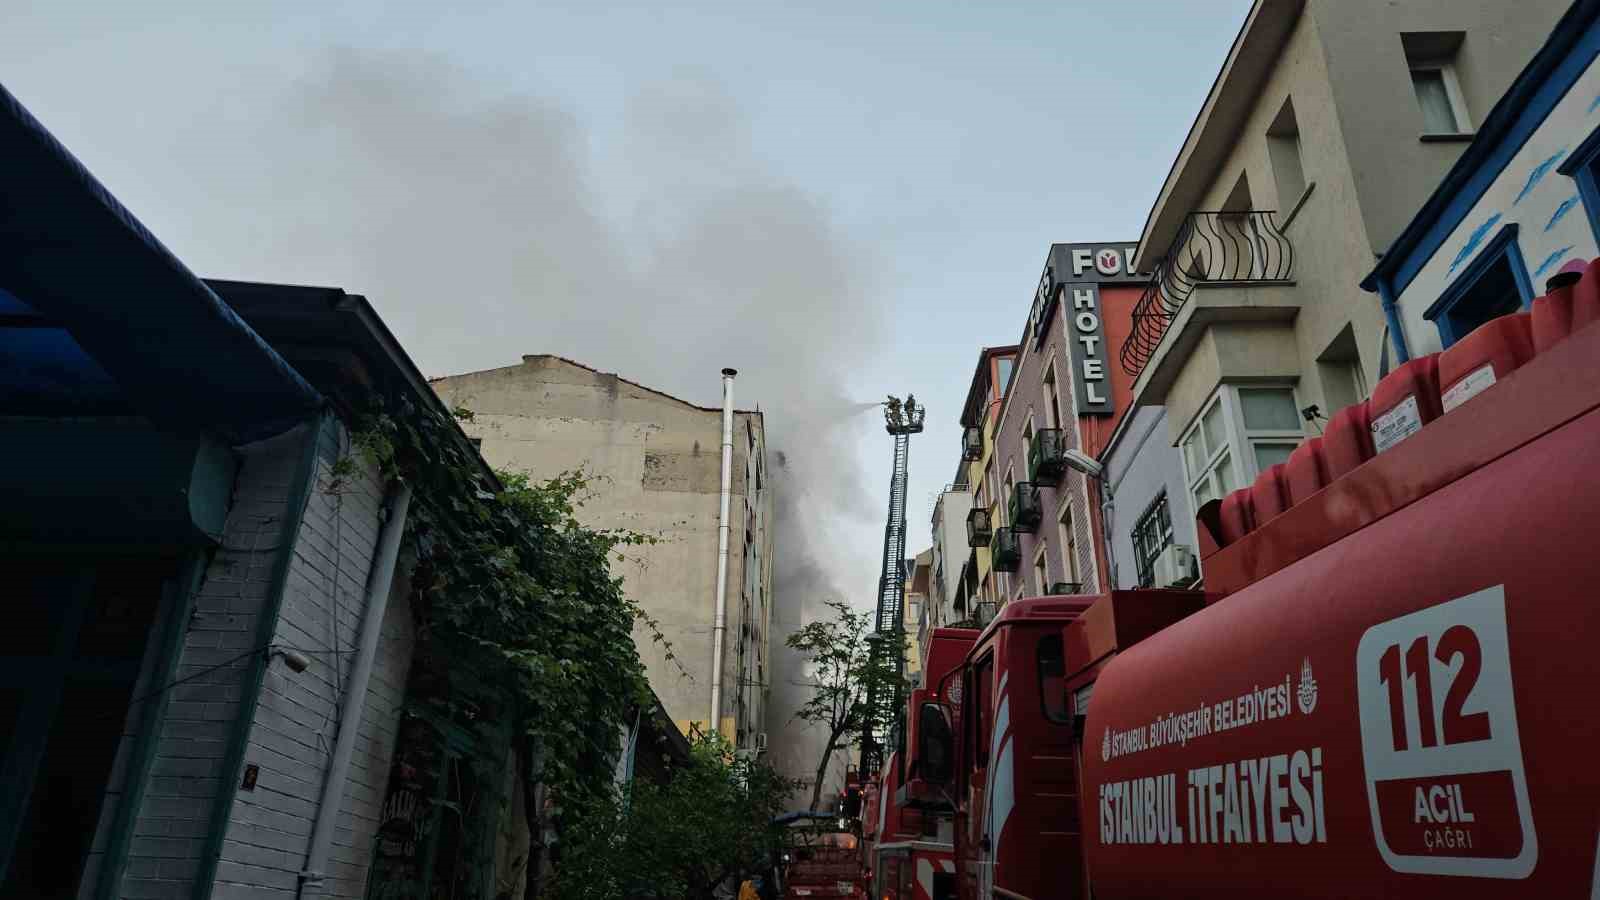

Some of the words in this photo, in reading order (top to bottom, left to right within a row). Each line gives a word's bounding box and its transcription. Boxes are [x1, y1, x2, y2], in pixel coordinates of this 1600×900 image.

[1073, 289, 1106, 403] HOTEL
[1112, 727, 1148, 758] İSTANBUL
[1150, 702, 1211, 747] BÜYÜKŞEHİR
[1214, 674, 1291, 732] BELEDİYESİ
[1379, 624, 1492, 752] 112
[1424, 827, 1472, 850] ÇAĞRI
